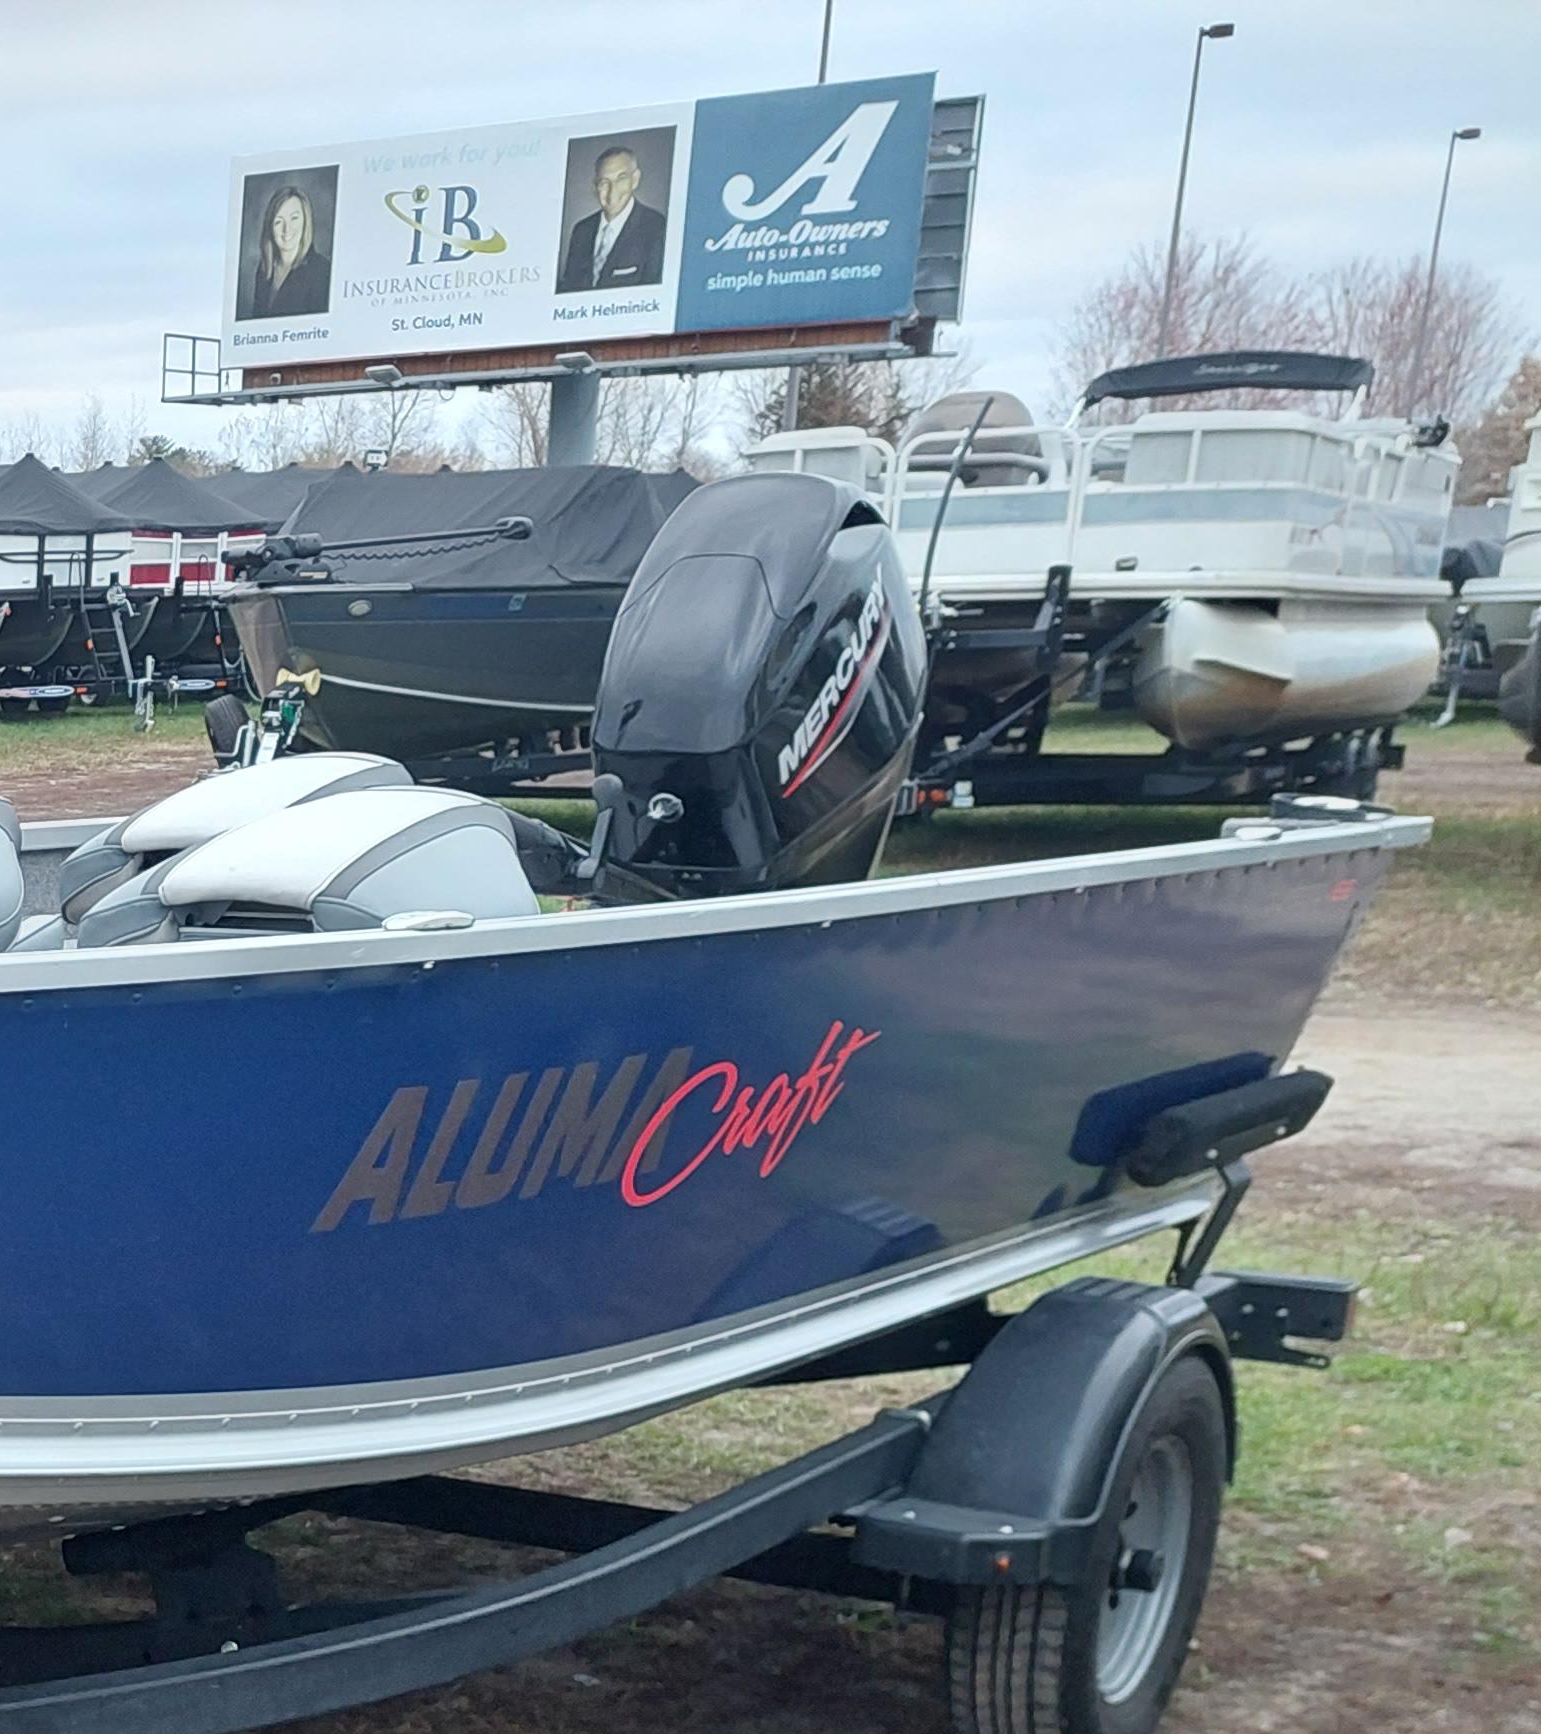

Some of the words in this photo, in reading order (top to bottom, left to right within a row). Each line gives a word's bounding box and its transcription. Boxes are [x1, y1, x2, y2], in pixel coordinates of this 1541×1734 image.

[363, 155, 396, 174] We
[402, 146, 453, 169] work
[459, 143, 488, 164] for
[495, 138, 542, 166] you!
[704, 217, 891, 252] Auto-Owners
[746, 243, 848, 262] INSURANCE
[706, 270, 764, 292] simple
[767, 268, 826, 286] human
[830, 263, 882, 280] sense
[370, 297, 386, 308] OF
[553, 304, 588, 320] Mark
[592, 299, 661, 318] Helminick
[391, 318, 408, 332] St.
[413, 314, 455, 331] Cloud,
[459, 312, 484, 326] MN
[233, 331, 279, 347] Brianna
[282, 326, 329, 344] Femrite
[778, 562, 885, 784] MERCURY
